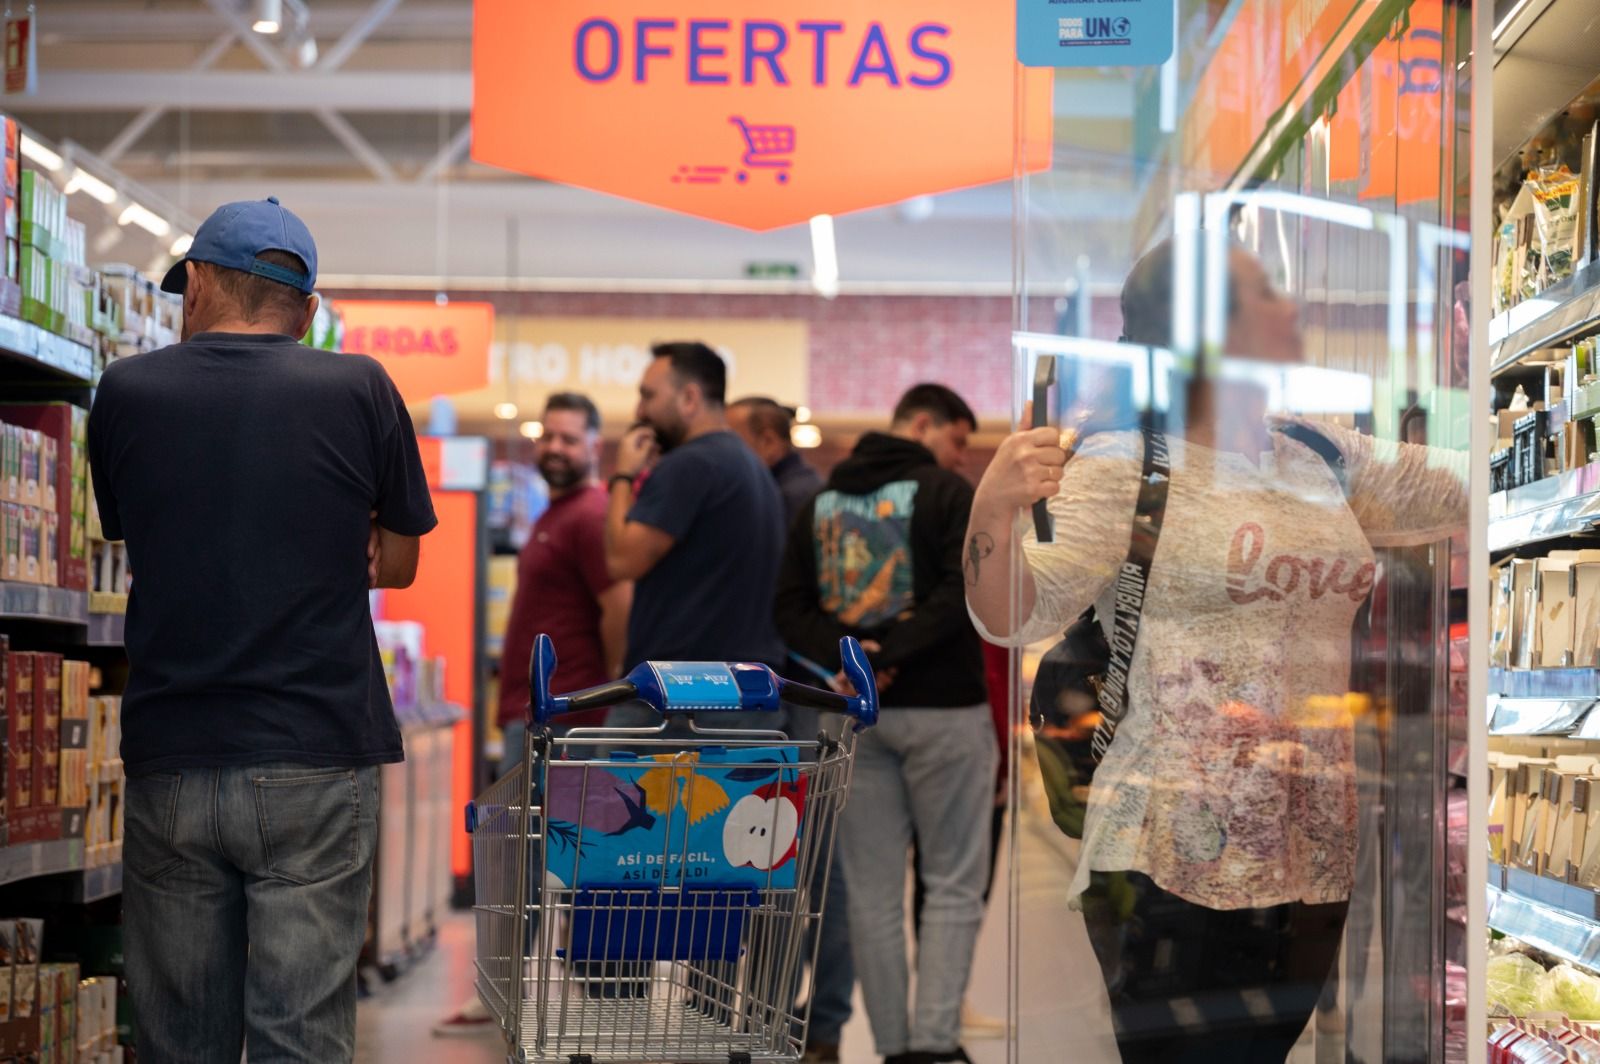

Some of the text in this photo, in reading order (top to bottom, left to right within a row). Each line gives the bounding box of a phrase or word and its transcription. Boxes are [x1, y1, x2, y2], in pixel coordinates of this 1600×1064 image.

[574, 17, 953, 88] OFERTAS
[617, 851, 641, 866] ASÍ
[646, 853, 665, 864] DE
[623, 866, 646, 880] ASÍ
